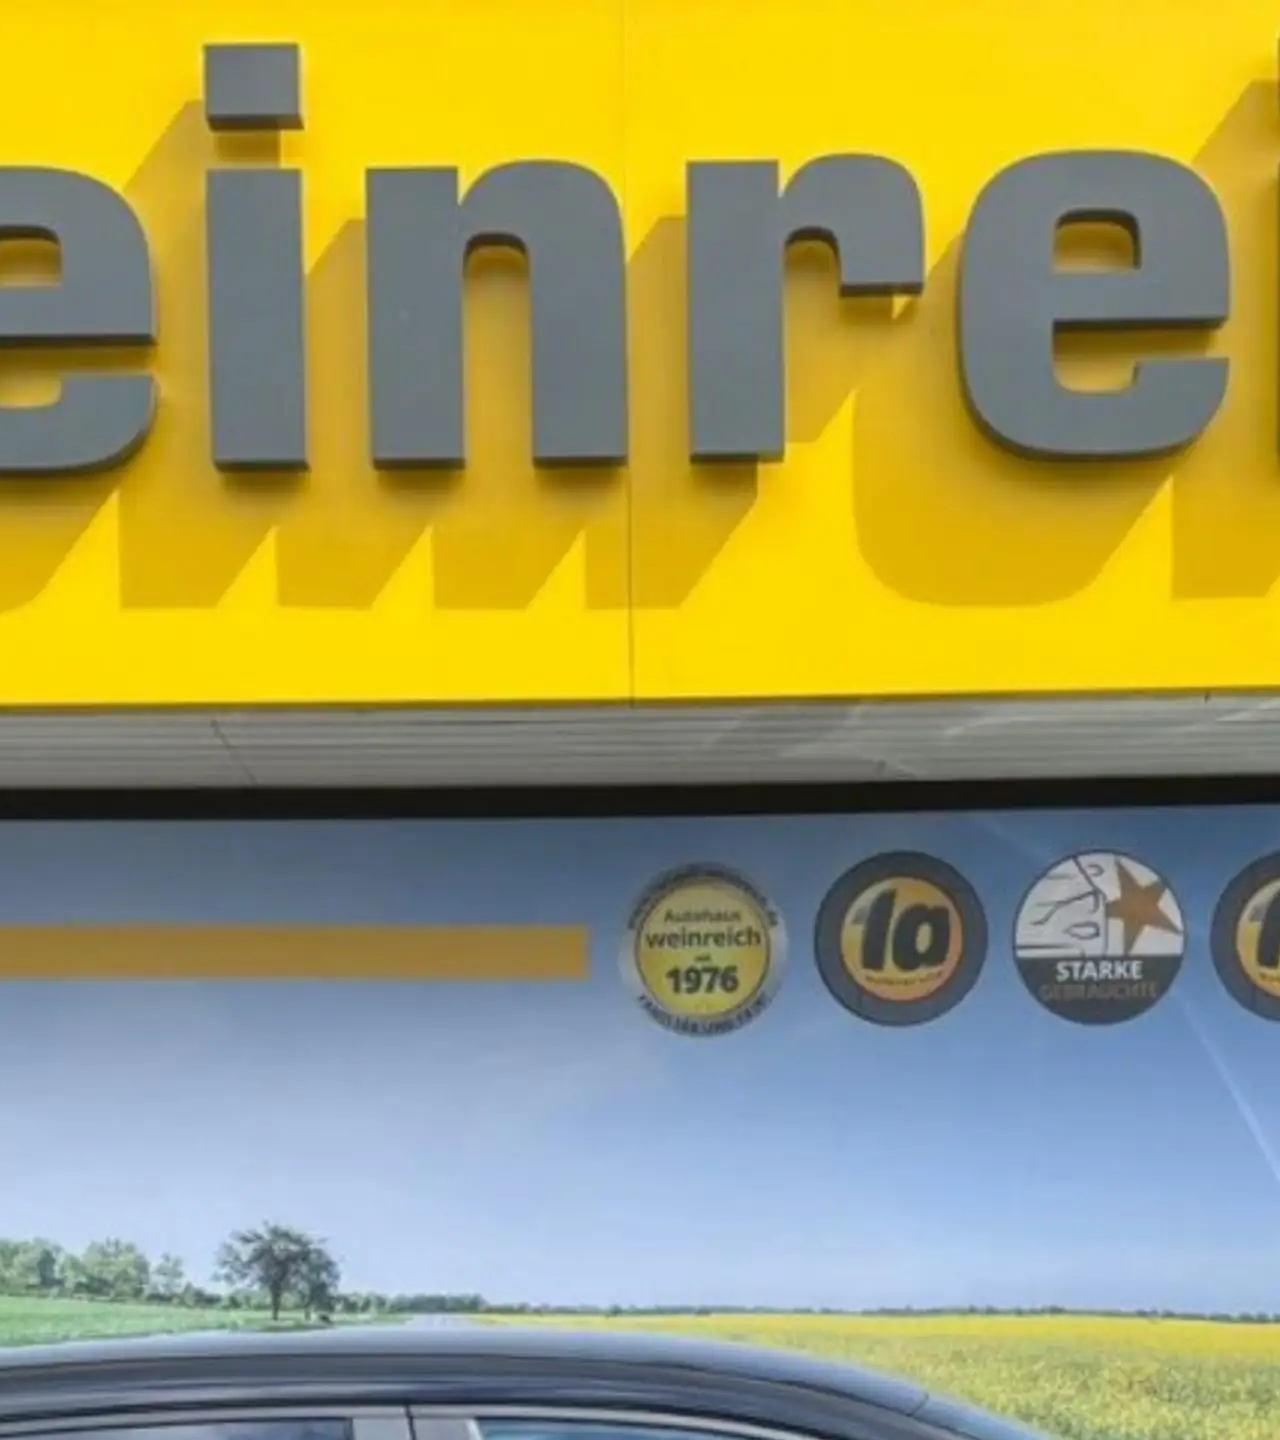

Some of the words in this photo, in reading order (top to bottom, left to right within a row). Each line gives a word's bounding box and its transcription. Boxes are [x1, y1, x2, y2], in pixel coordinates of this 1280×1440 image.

[664, 908, 742, 923] Autohaus
[645, 925, 762, 949] weinreich
[664, 965, 740, 995] 1976
[1055, 959, 1145, 983] STARKE
